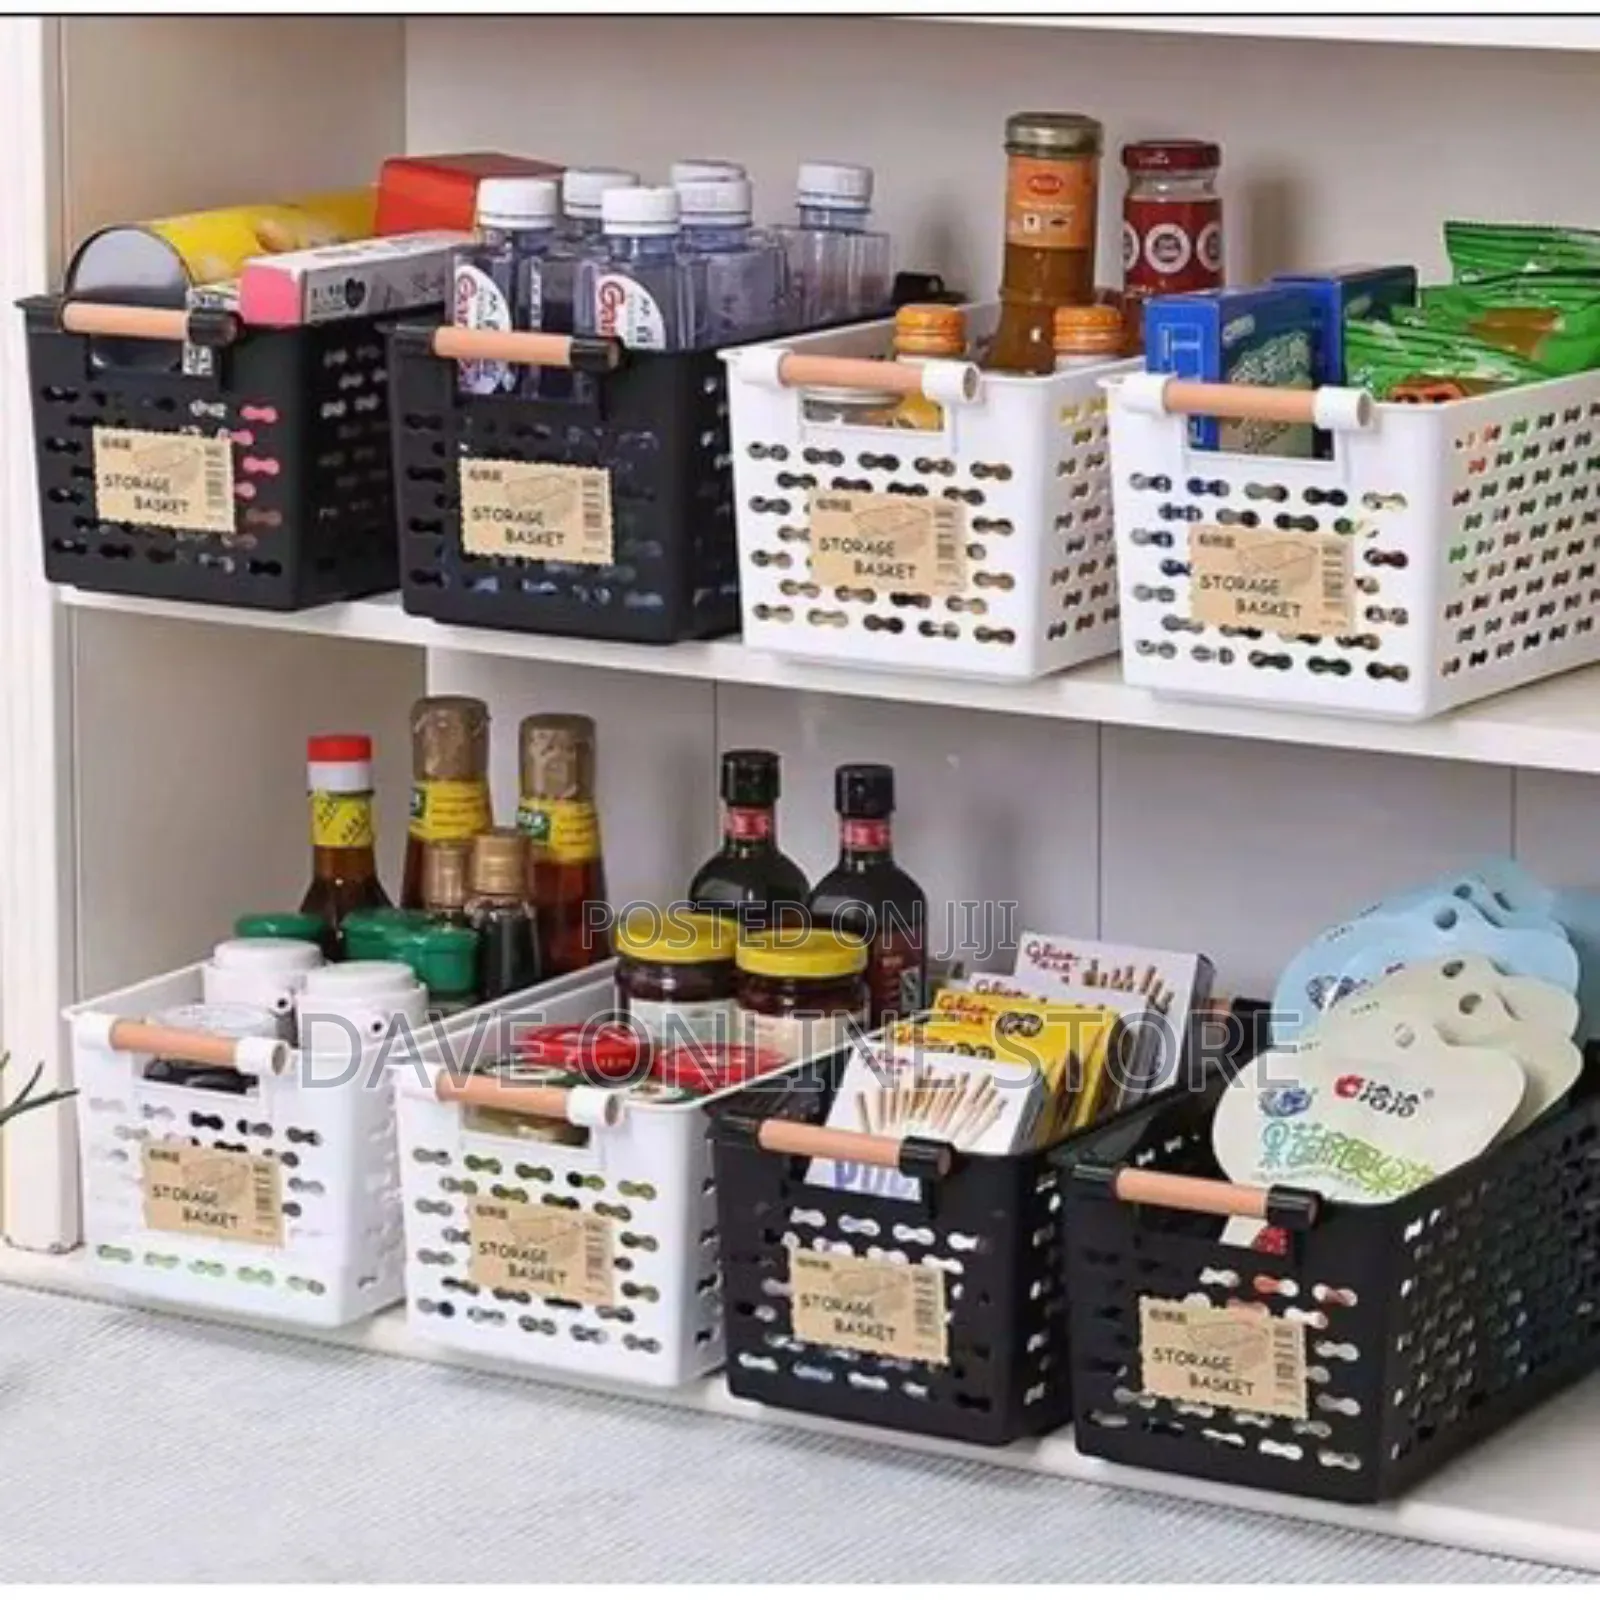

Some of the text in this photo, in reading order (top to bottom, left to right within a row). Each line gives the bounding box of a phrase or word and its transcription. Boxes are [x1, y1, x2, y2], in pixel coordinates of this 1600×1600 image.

[104, 473, 171, 496] STORAGE
[134, 495, 189, 515] BASKET
[472, 504, 544, 527] STORAGE
[505, 527, 564, 548] BASKET
[819, 537, 895, 557] STORAGE
[854, 560, 917, 579] BASKET
[1201, 575, 1280, 595] STORAGE
[1235, 598, 1303, 618] BASKET
[153, 1184, 219, 1207] STORAGE
[182, 1207, 238, 1229] BASKET
[479, 1241, 548, 1263] STORAGE
[508, 1263, 567, 1284] BASKET
[802, 1293, 874, 1317] STORAGE
[834, 1317, 897, 1341] BASKET
[1152, 1347, 1233, 1372] STORAGE
[1189, 1372, 1255, 1396] BASKET
